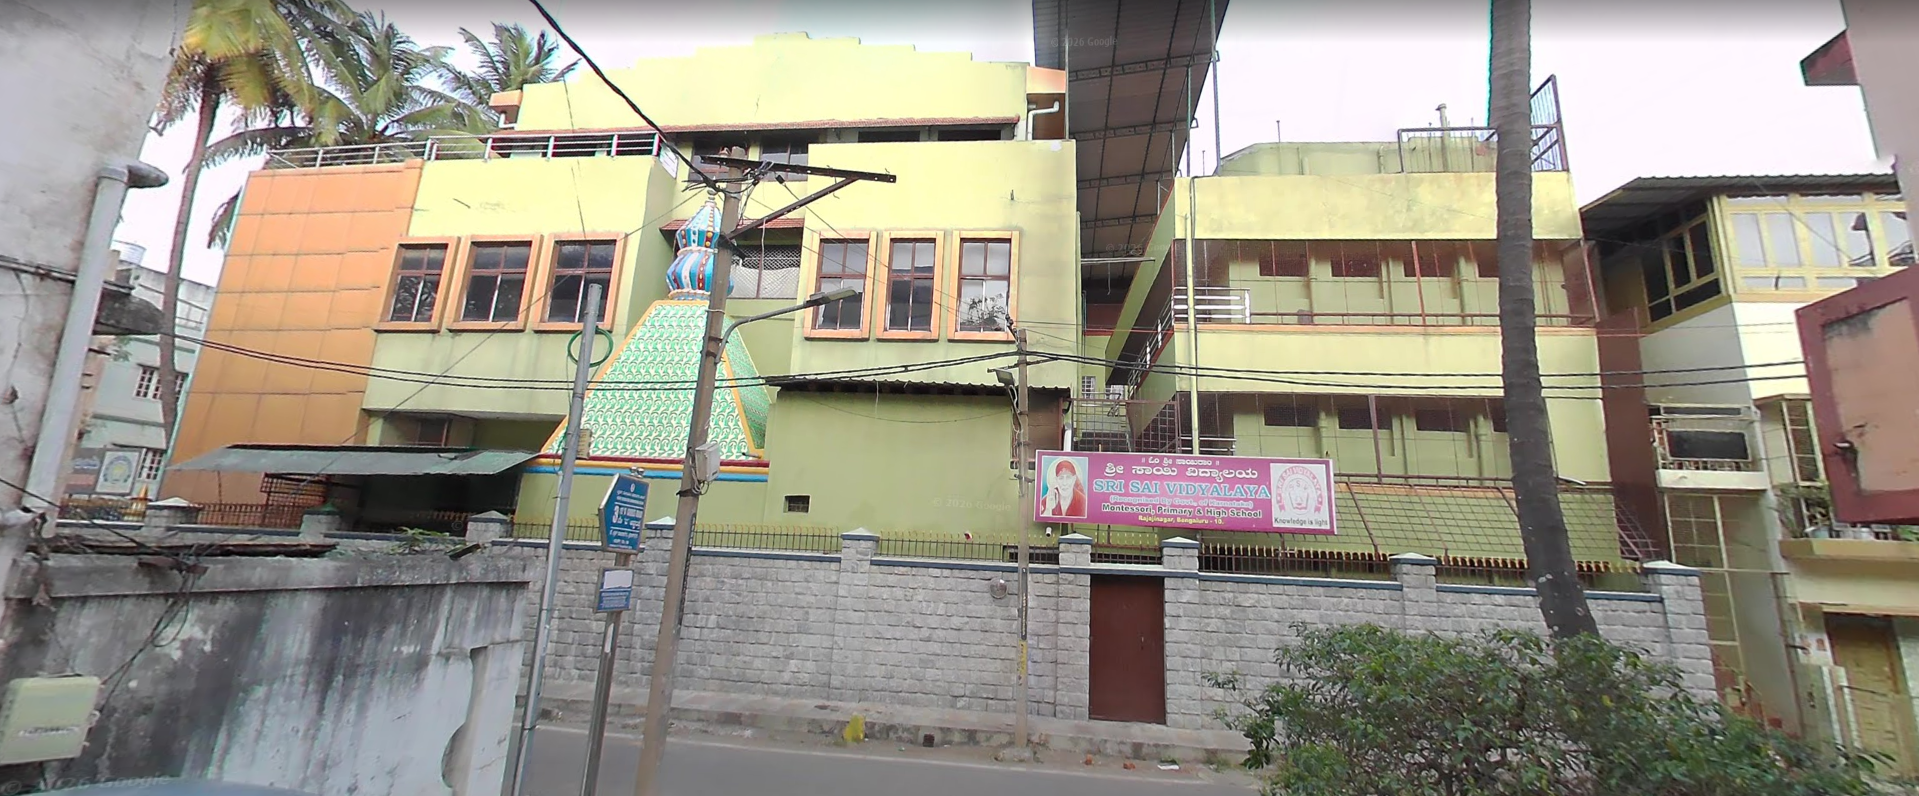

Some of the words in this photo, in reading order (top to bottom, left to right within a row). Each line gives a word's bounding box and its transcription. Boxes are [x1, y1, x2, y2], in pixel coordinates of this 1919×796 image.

[1104, 462, 1124, 477] ಶ್ರೀ
[1132, 465, 1177, 476] ಸಾಯಿ
[1186, 466, 1258, 482] ವಿದ್ಯಾಲಯ
[1093, 479, 1124, 493] SRI
[1130, 480, 1160, 495] SAI
[1165, 482, 1271, 498] VIDYALAYA
[1102, 503, 1155, 514] Montessori,
[1157, 506, 1193, 517] Primary
[1195, 508, 1203, 516] &
[1206, 508, 1227, 518] High
[1230, 509, 1262, 518] School
[1176, 516, 1209, 525] Bengaluru
[1274, 517, 1307, 526] Knowledge
[1315, 519, 1328, 527] light
